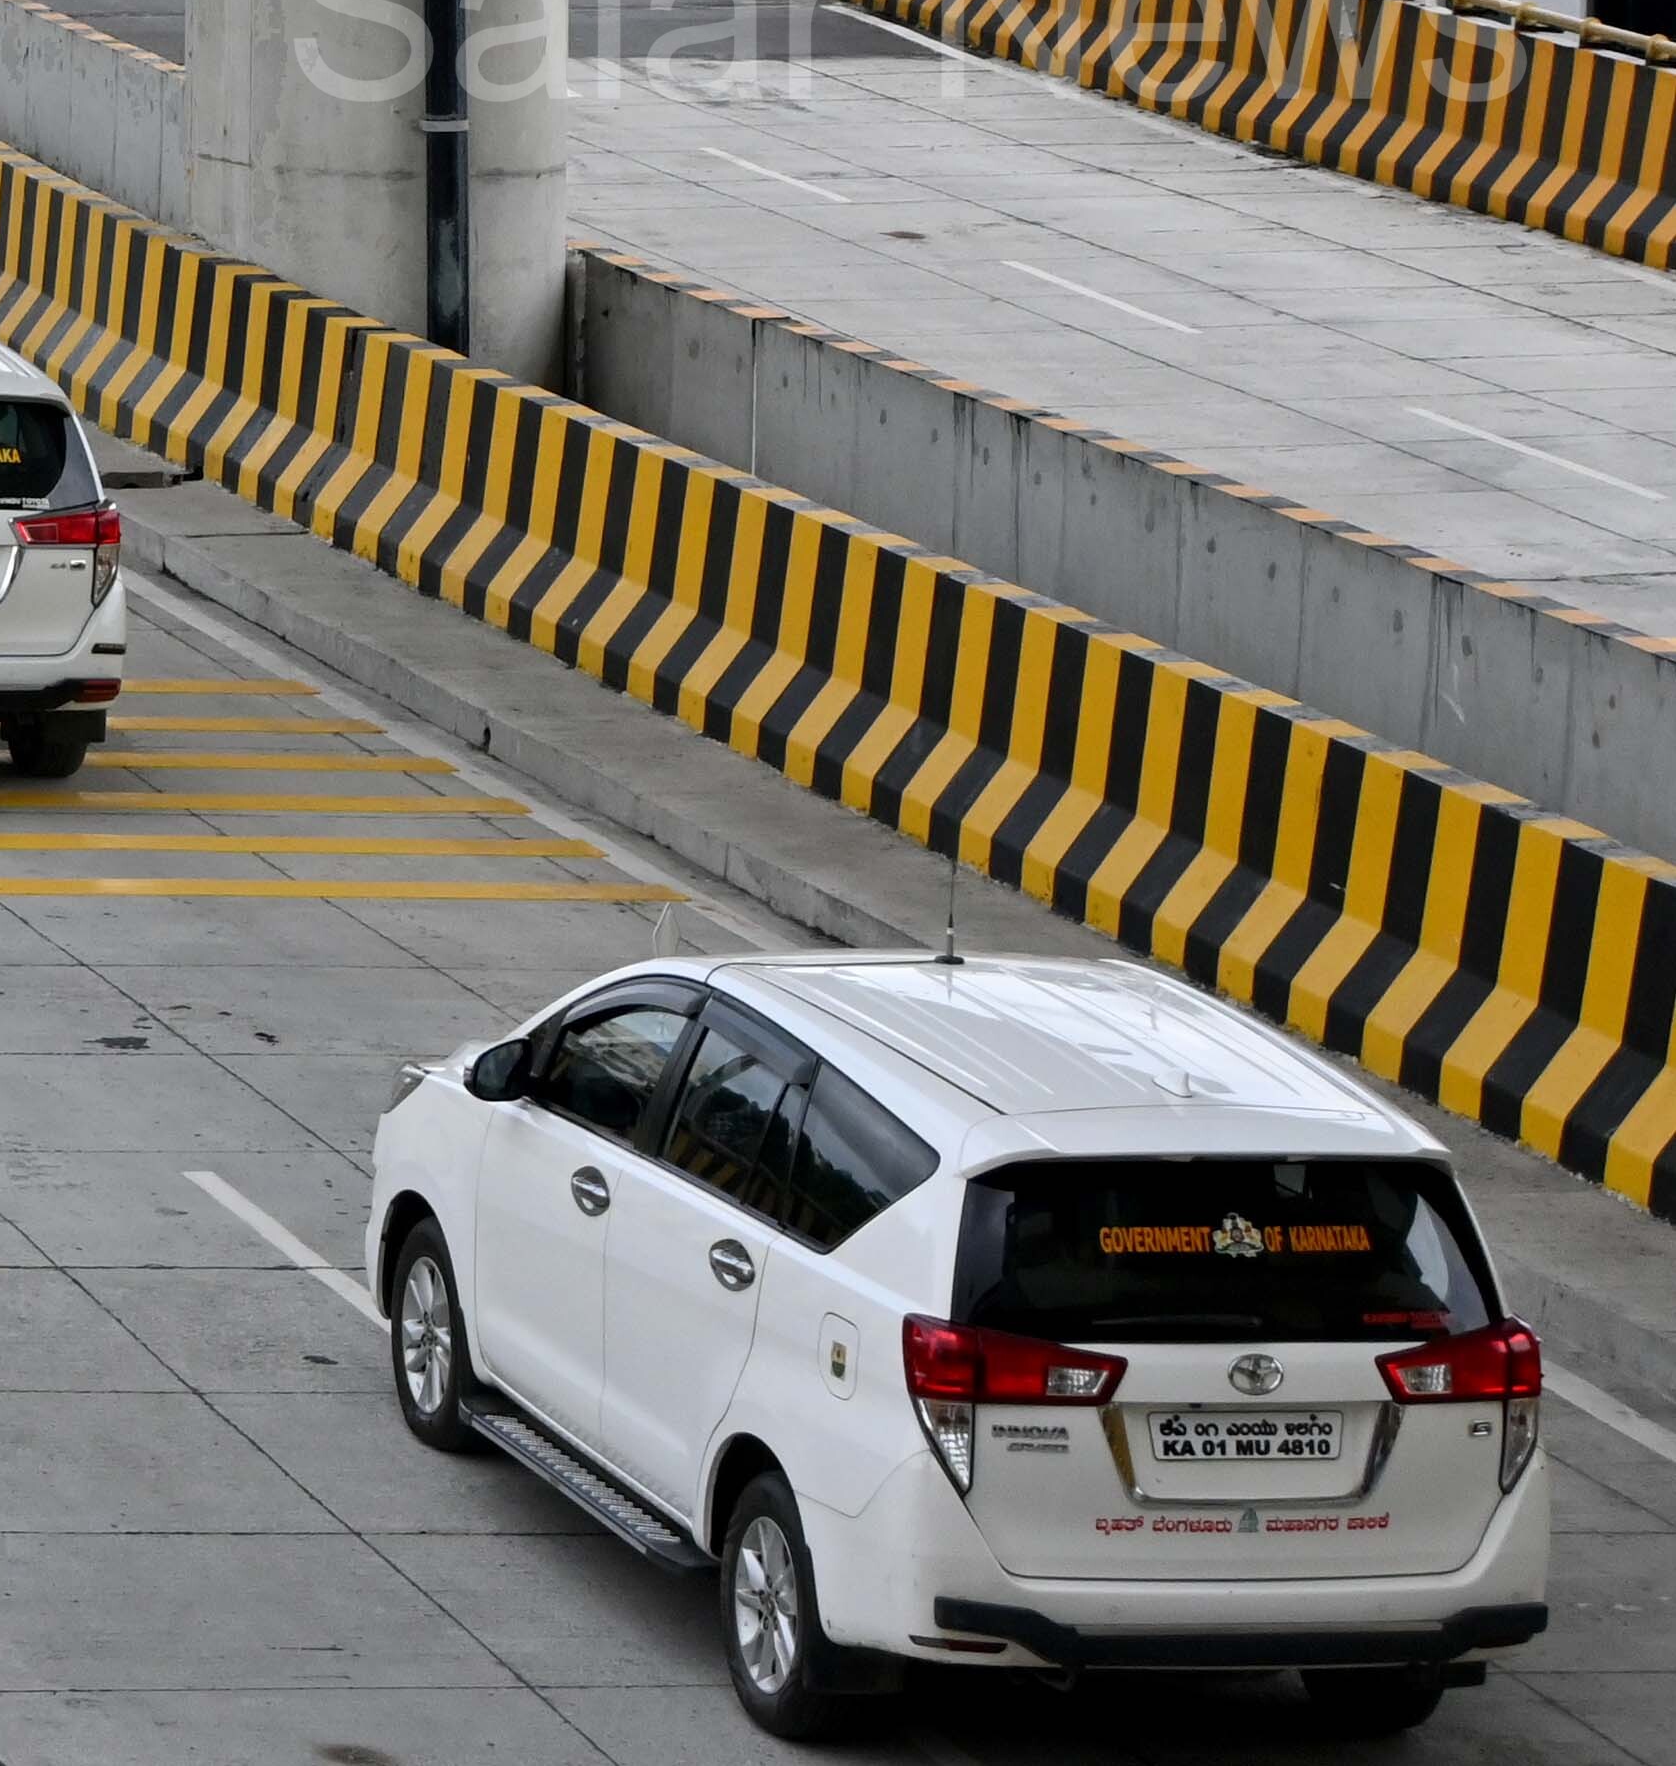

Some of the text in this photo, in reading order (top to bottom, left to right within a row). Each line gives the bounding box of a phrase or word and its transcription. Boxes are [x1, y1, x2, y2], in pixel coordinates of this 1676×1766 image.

[1100, 1225, 1371, 1253] GOVERNMENT OF KARNATAKA
[1162, 1439, 1331, 1456] KA 01 MU 4810
